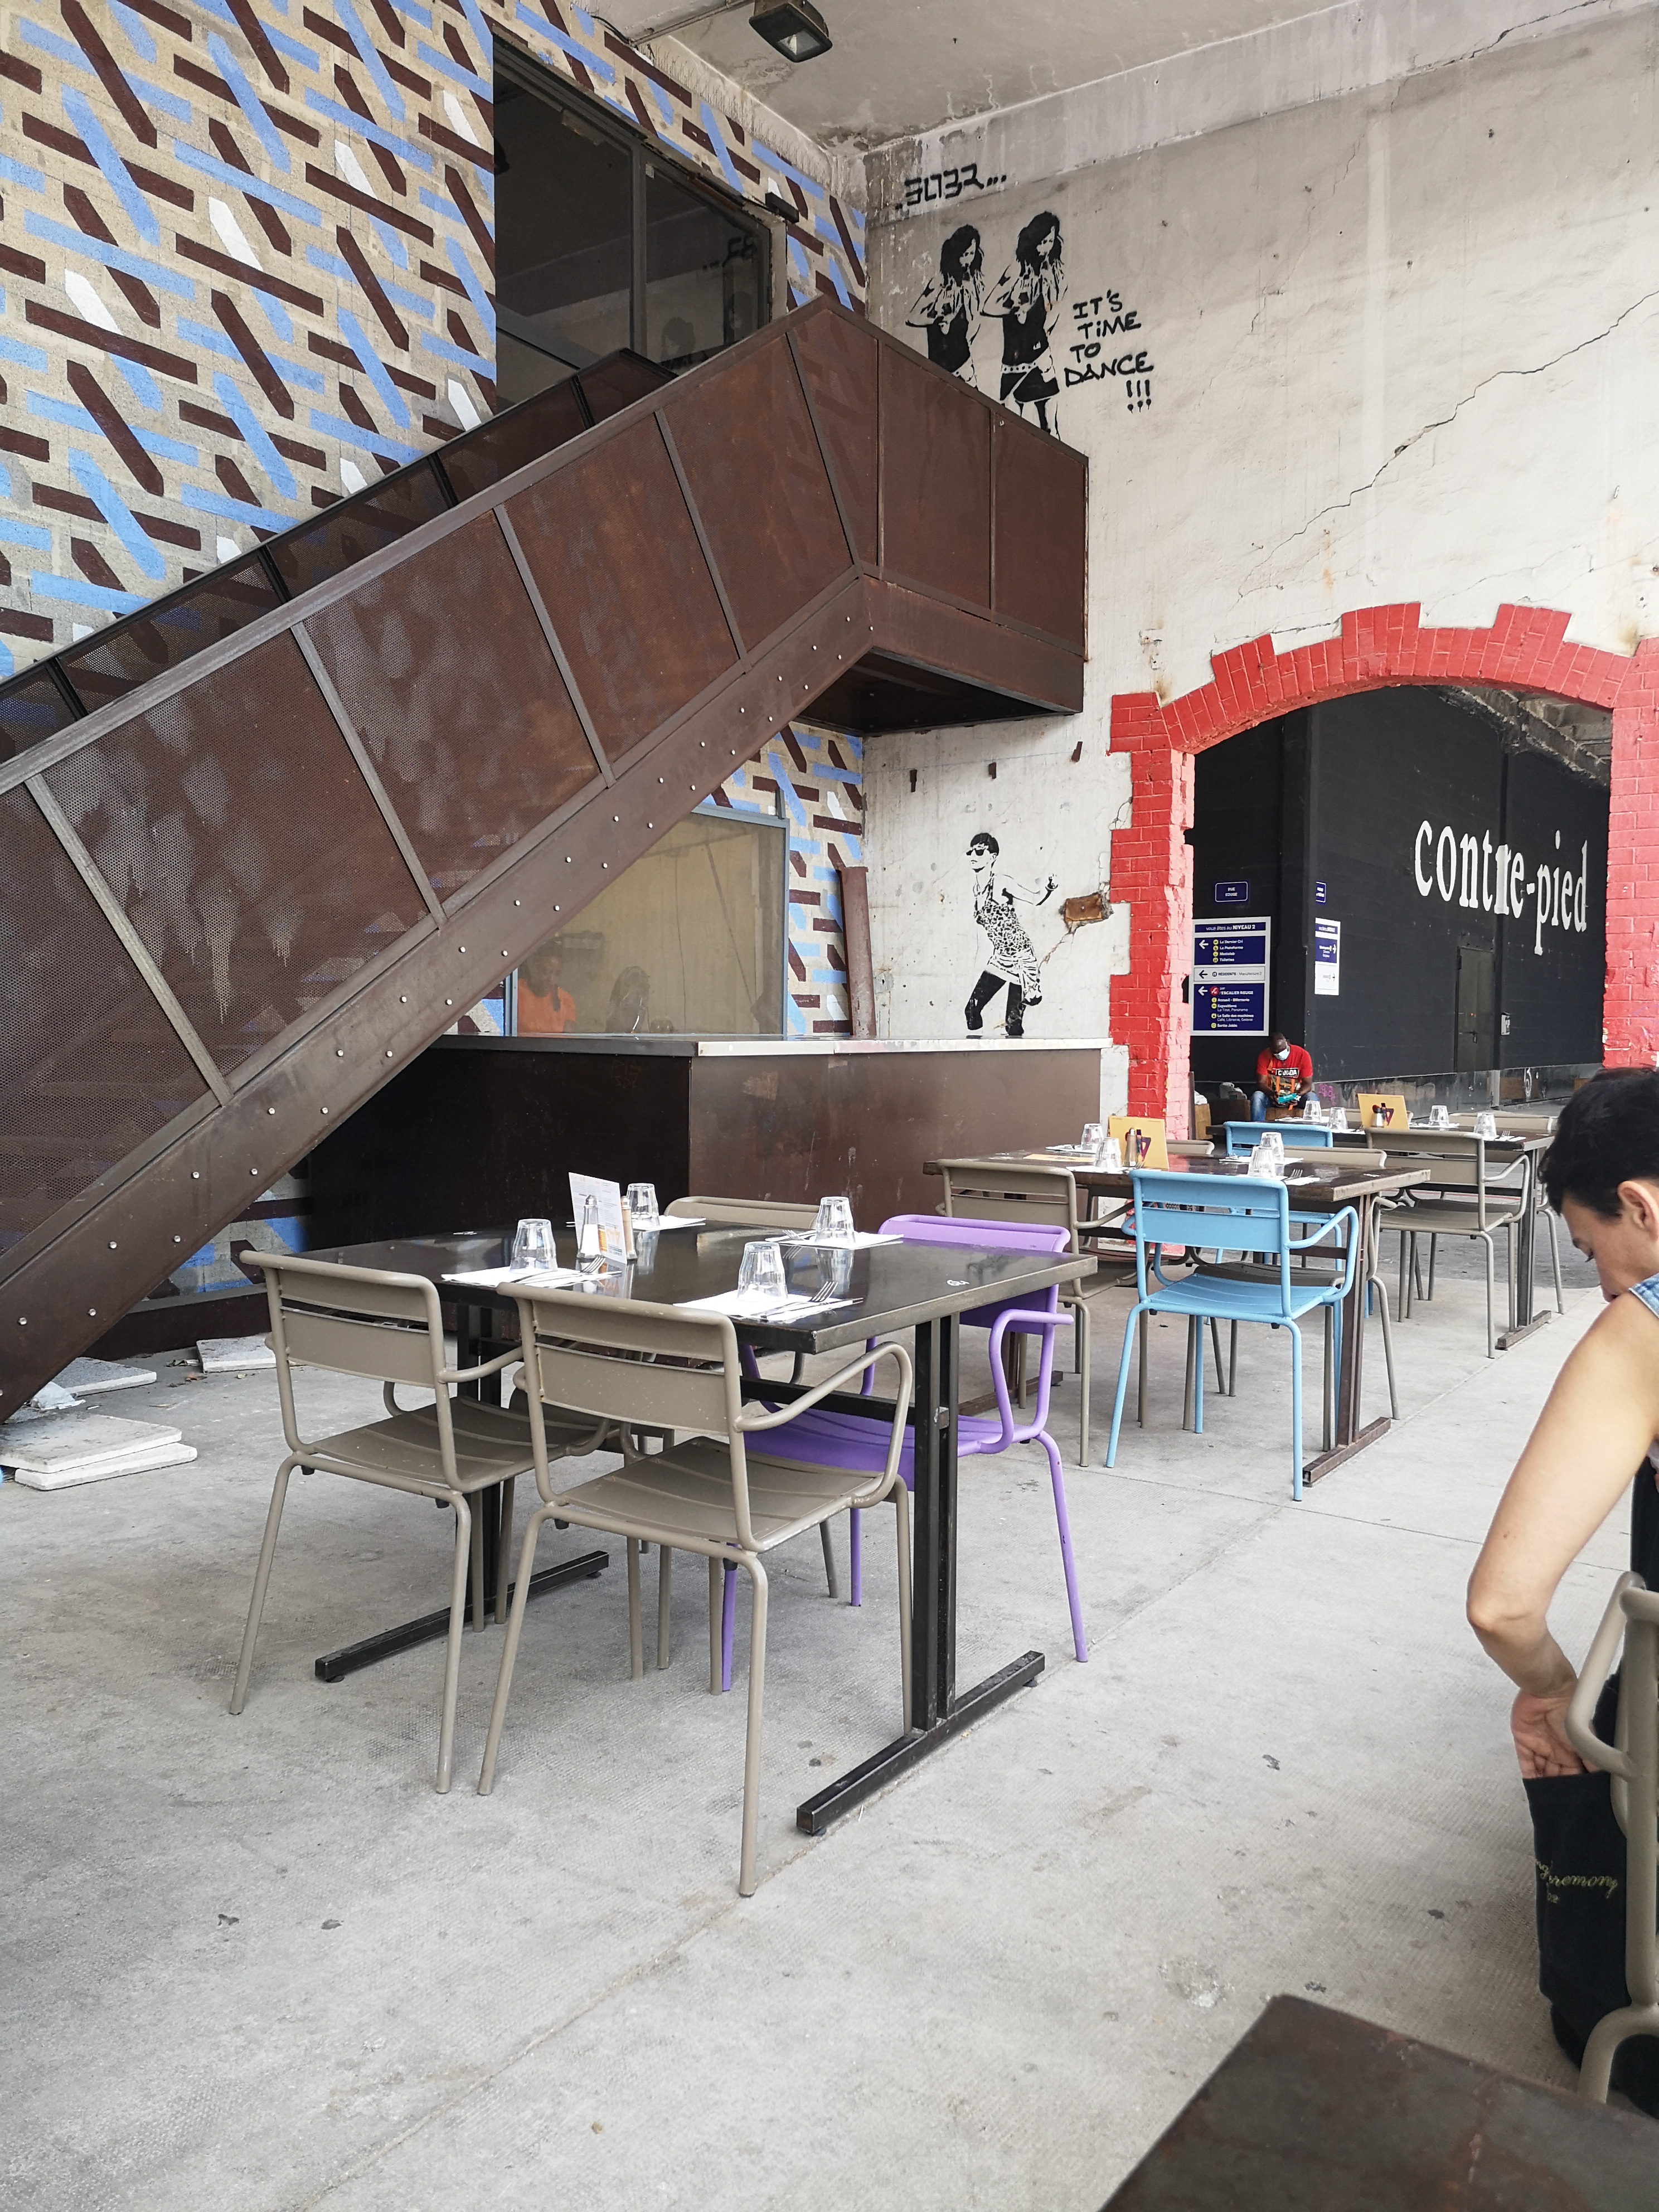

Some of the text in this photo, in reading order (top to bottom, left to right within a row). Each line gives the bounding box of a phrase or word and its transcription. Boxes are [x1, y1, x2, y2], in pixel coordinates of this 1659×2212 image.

[1073, 289, 1123, 319] IT'S
[1069, 342, 1101, 363] TO
[1064, 351, 1154, 388] DANCE
